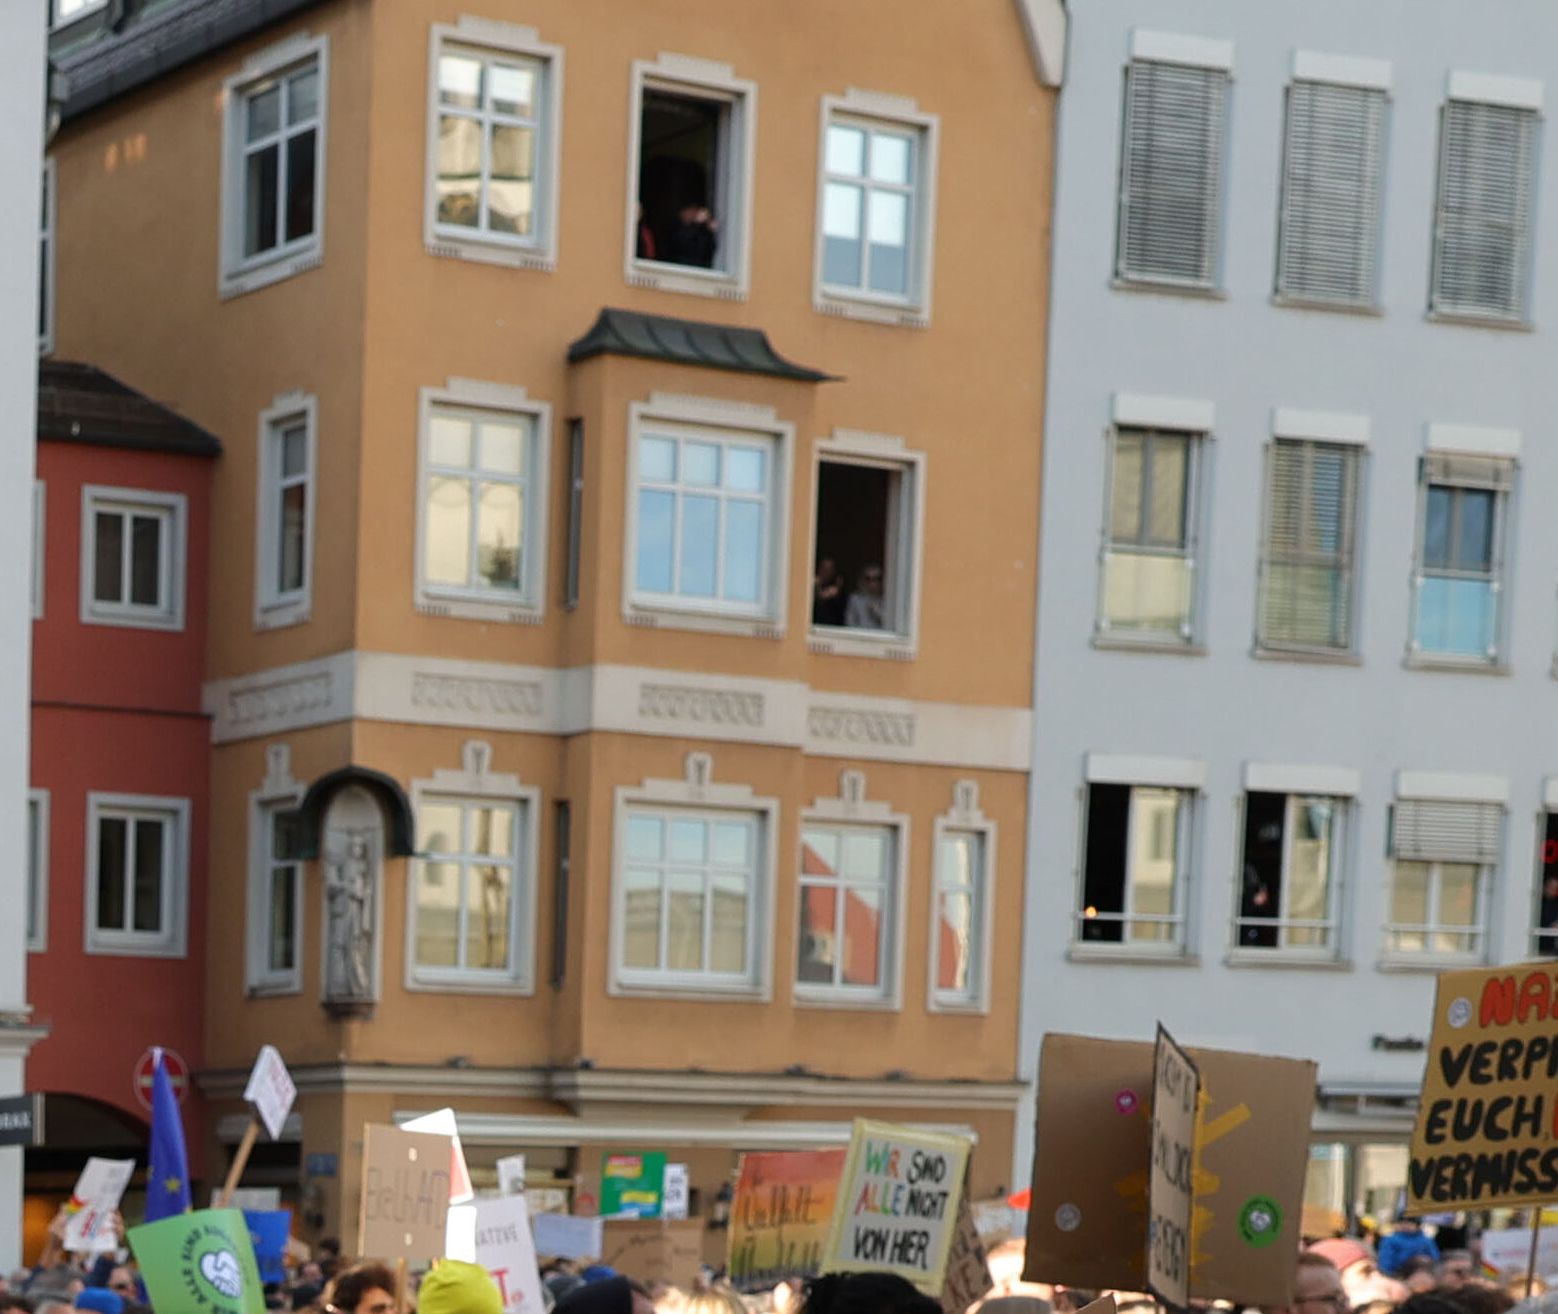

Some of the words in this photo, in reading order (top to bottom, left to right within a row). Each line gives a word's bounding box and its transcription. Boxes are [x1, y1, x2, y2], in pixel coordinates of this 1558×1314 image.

[865, 1141, 901, 1179] WIR
[855, 1183, 906, 1218] ALLE
[905, 1186, 950, 1221] NICHT
[853, 1225, 889, 1263] VON
[889, 1229, 931, 1271] HIER
